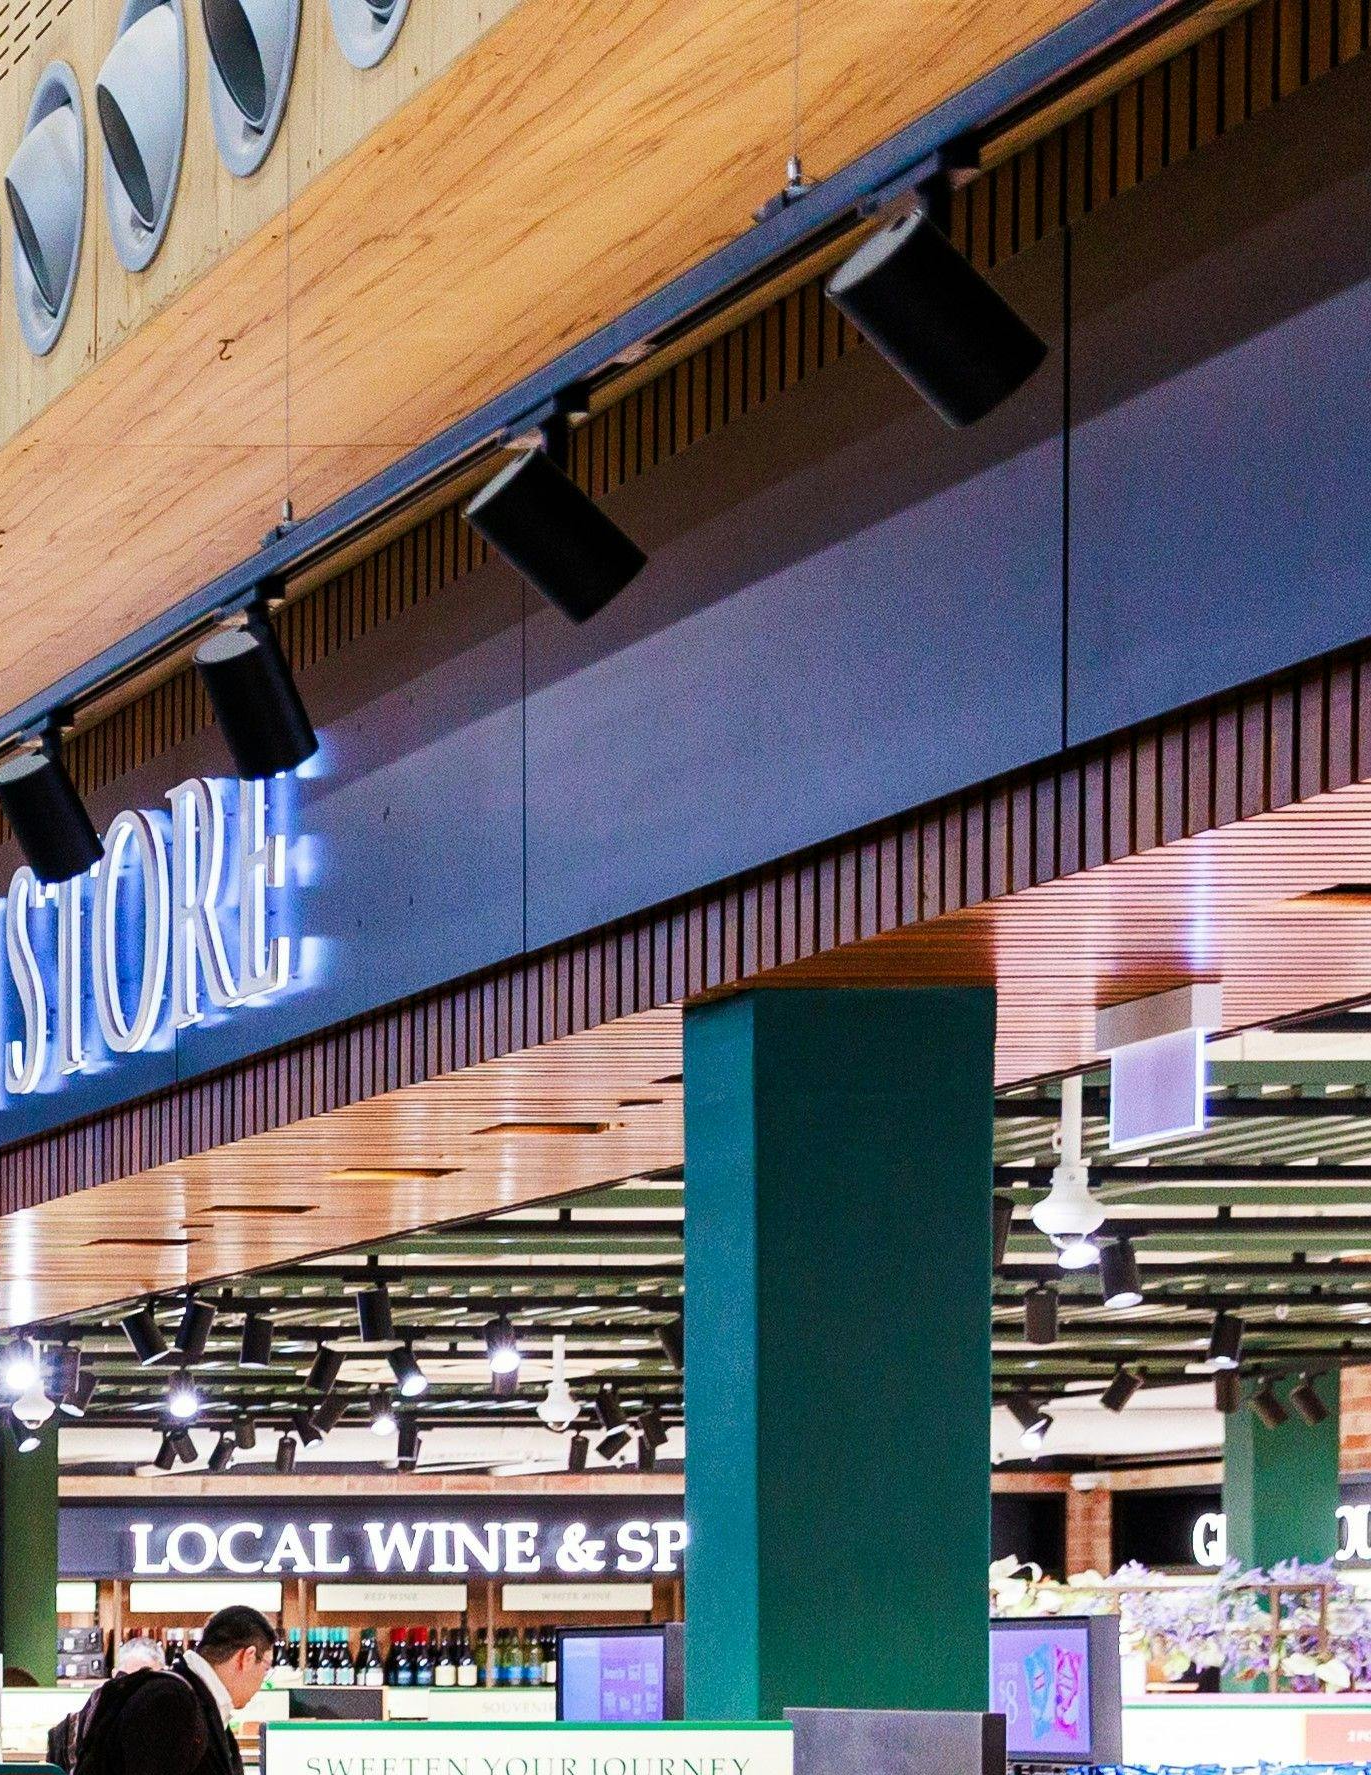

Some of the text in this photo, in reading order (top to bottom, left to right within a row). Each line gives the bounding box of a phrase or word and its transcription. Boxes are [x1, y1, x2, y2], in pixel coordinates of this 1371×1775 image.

[5, 774, 290, 1095] STORE
[128, 1522, 350, 1573] LOCAL
[362, 1521, 541, 1573] WINE
[554, 1523, 606, 1572] &
